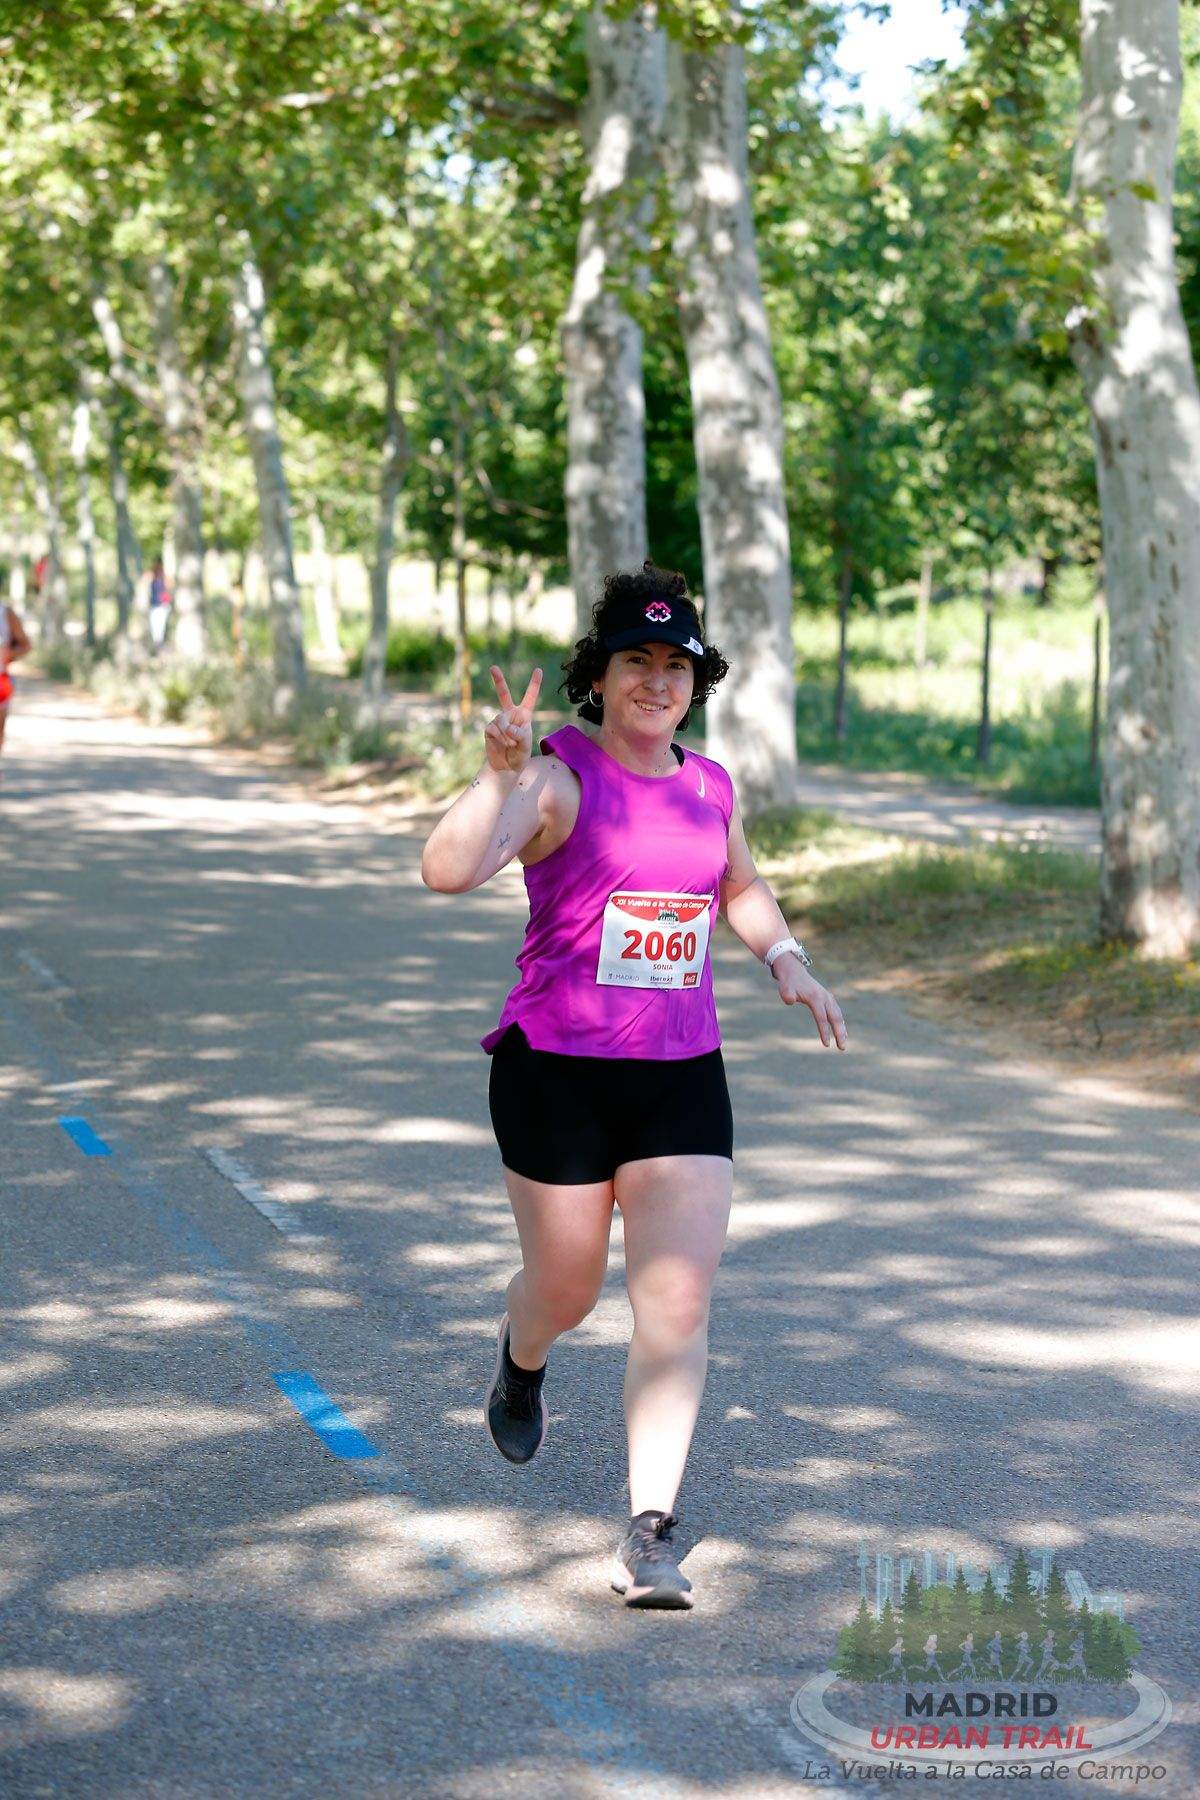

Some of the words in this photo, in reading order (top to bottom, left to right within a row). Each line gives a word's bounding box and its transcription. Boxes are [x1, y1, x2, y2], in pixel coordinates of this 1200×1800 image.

[628, 899, 651, 907] Vuelta
[689, 901, 705, 910] Campo
[621, 929, 697, 962] 2060
[653, 963, 673, 971] SONIA
[615, 973, 640, 981] MADRID
